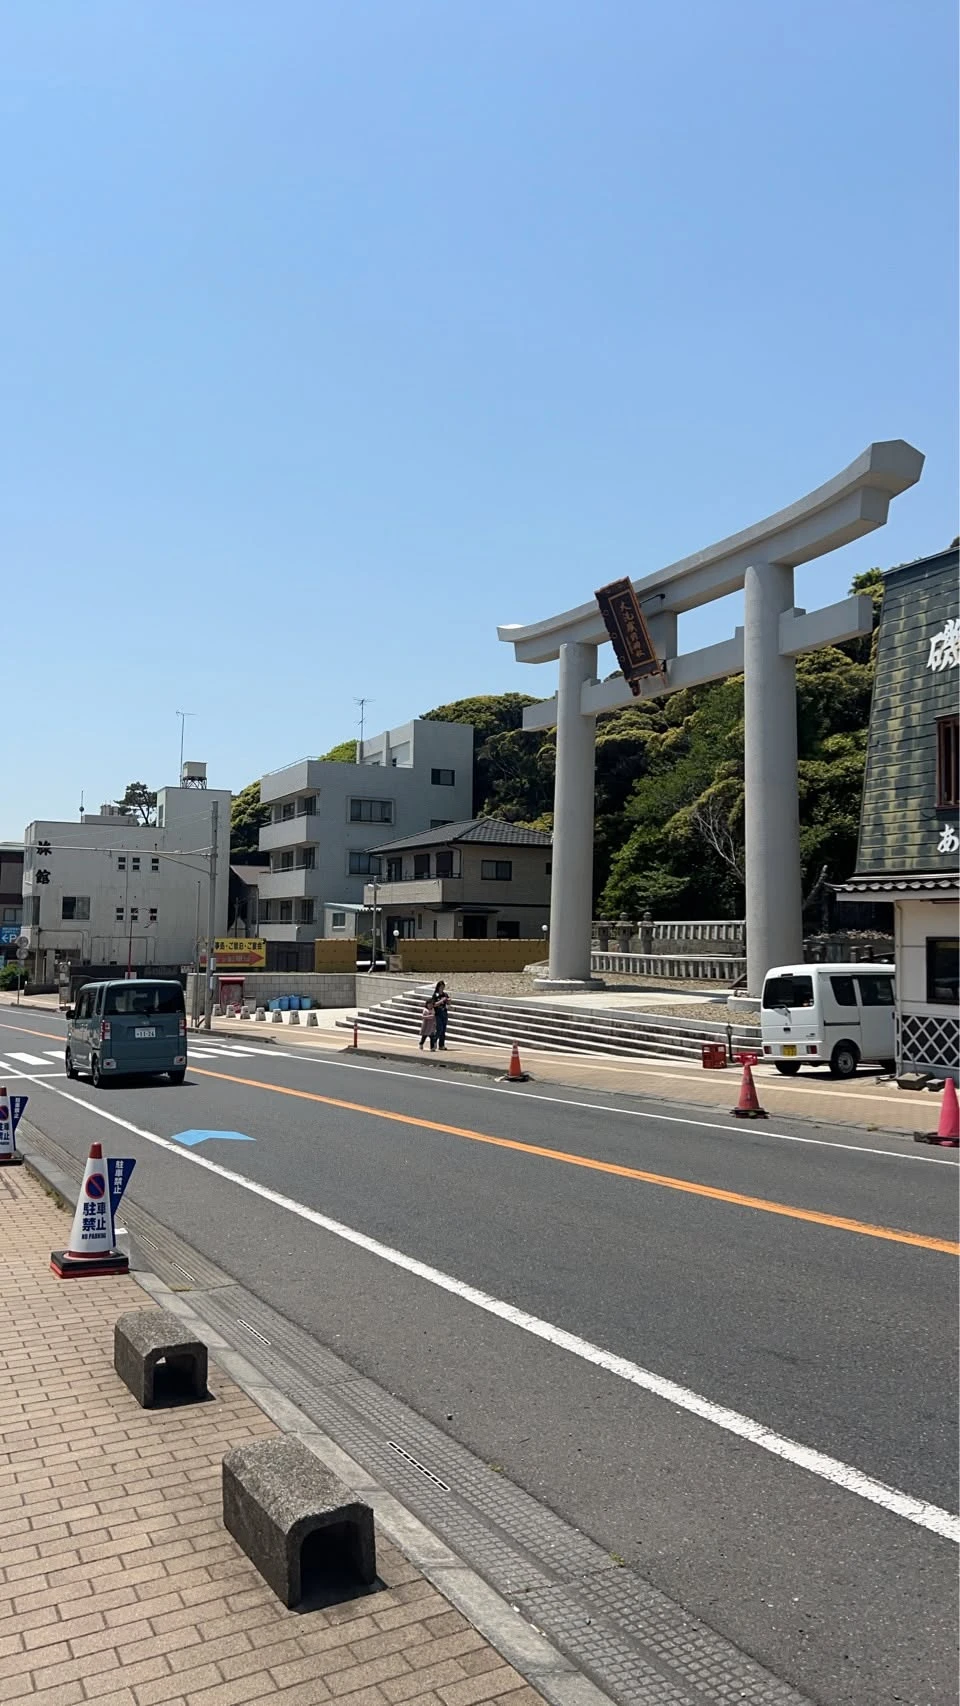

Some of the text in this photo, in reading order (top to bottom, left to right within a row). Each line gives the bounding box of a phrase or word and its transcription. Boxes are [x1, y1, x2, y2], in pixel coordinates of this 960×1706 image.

[936, 823, 959, 853] あ
[9, 934, 17, 943] P
[113, 1160, 124, 1194] 駐車禁止
[83, 1201, 106, 1216] 駐車
[82, 1216, 106, 1232] 禁止
